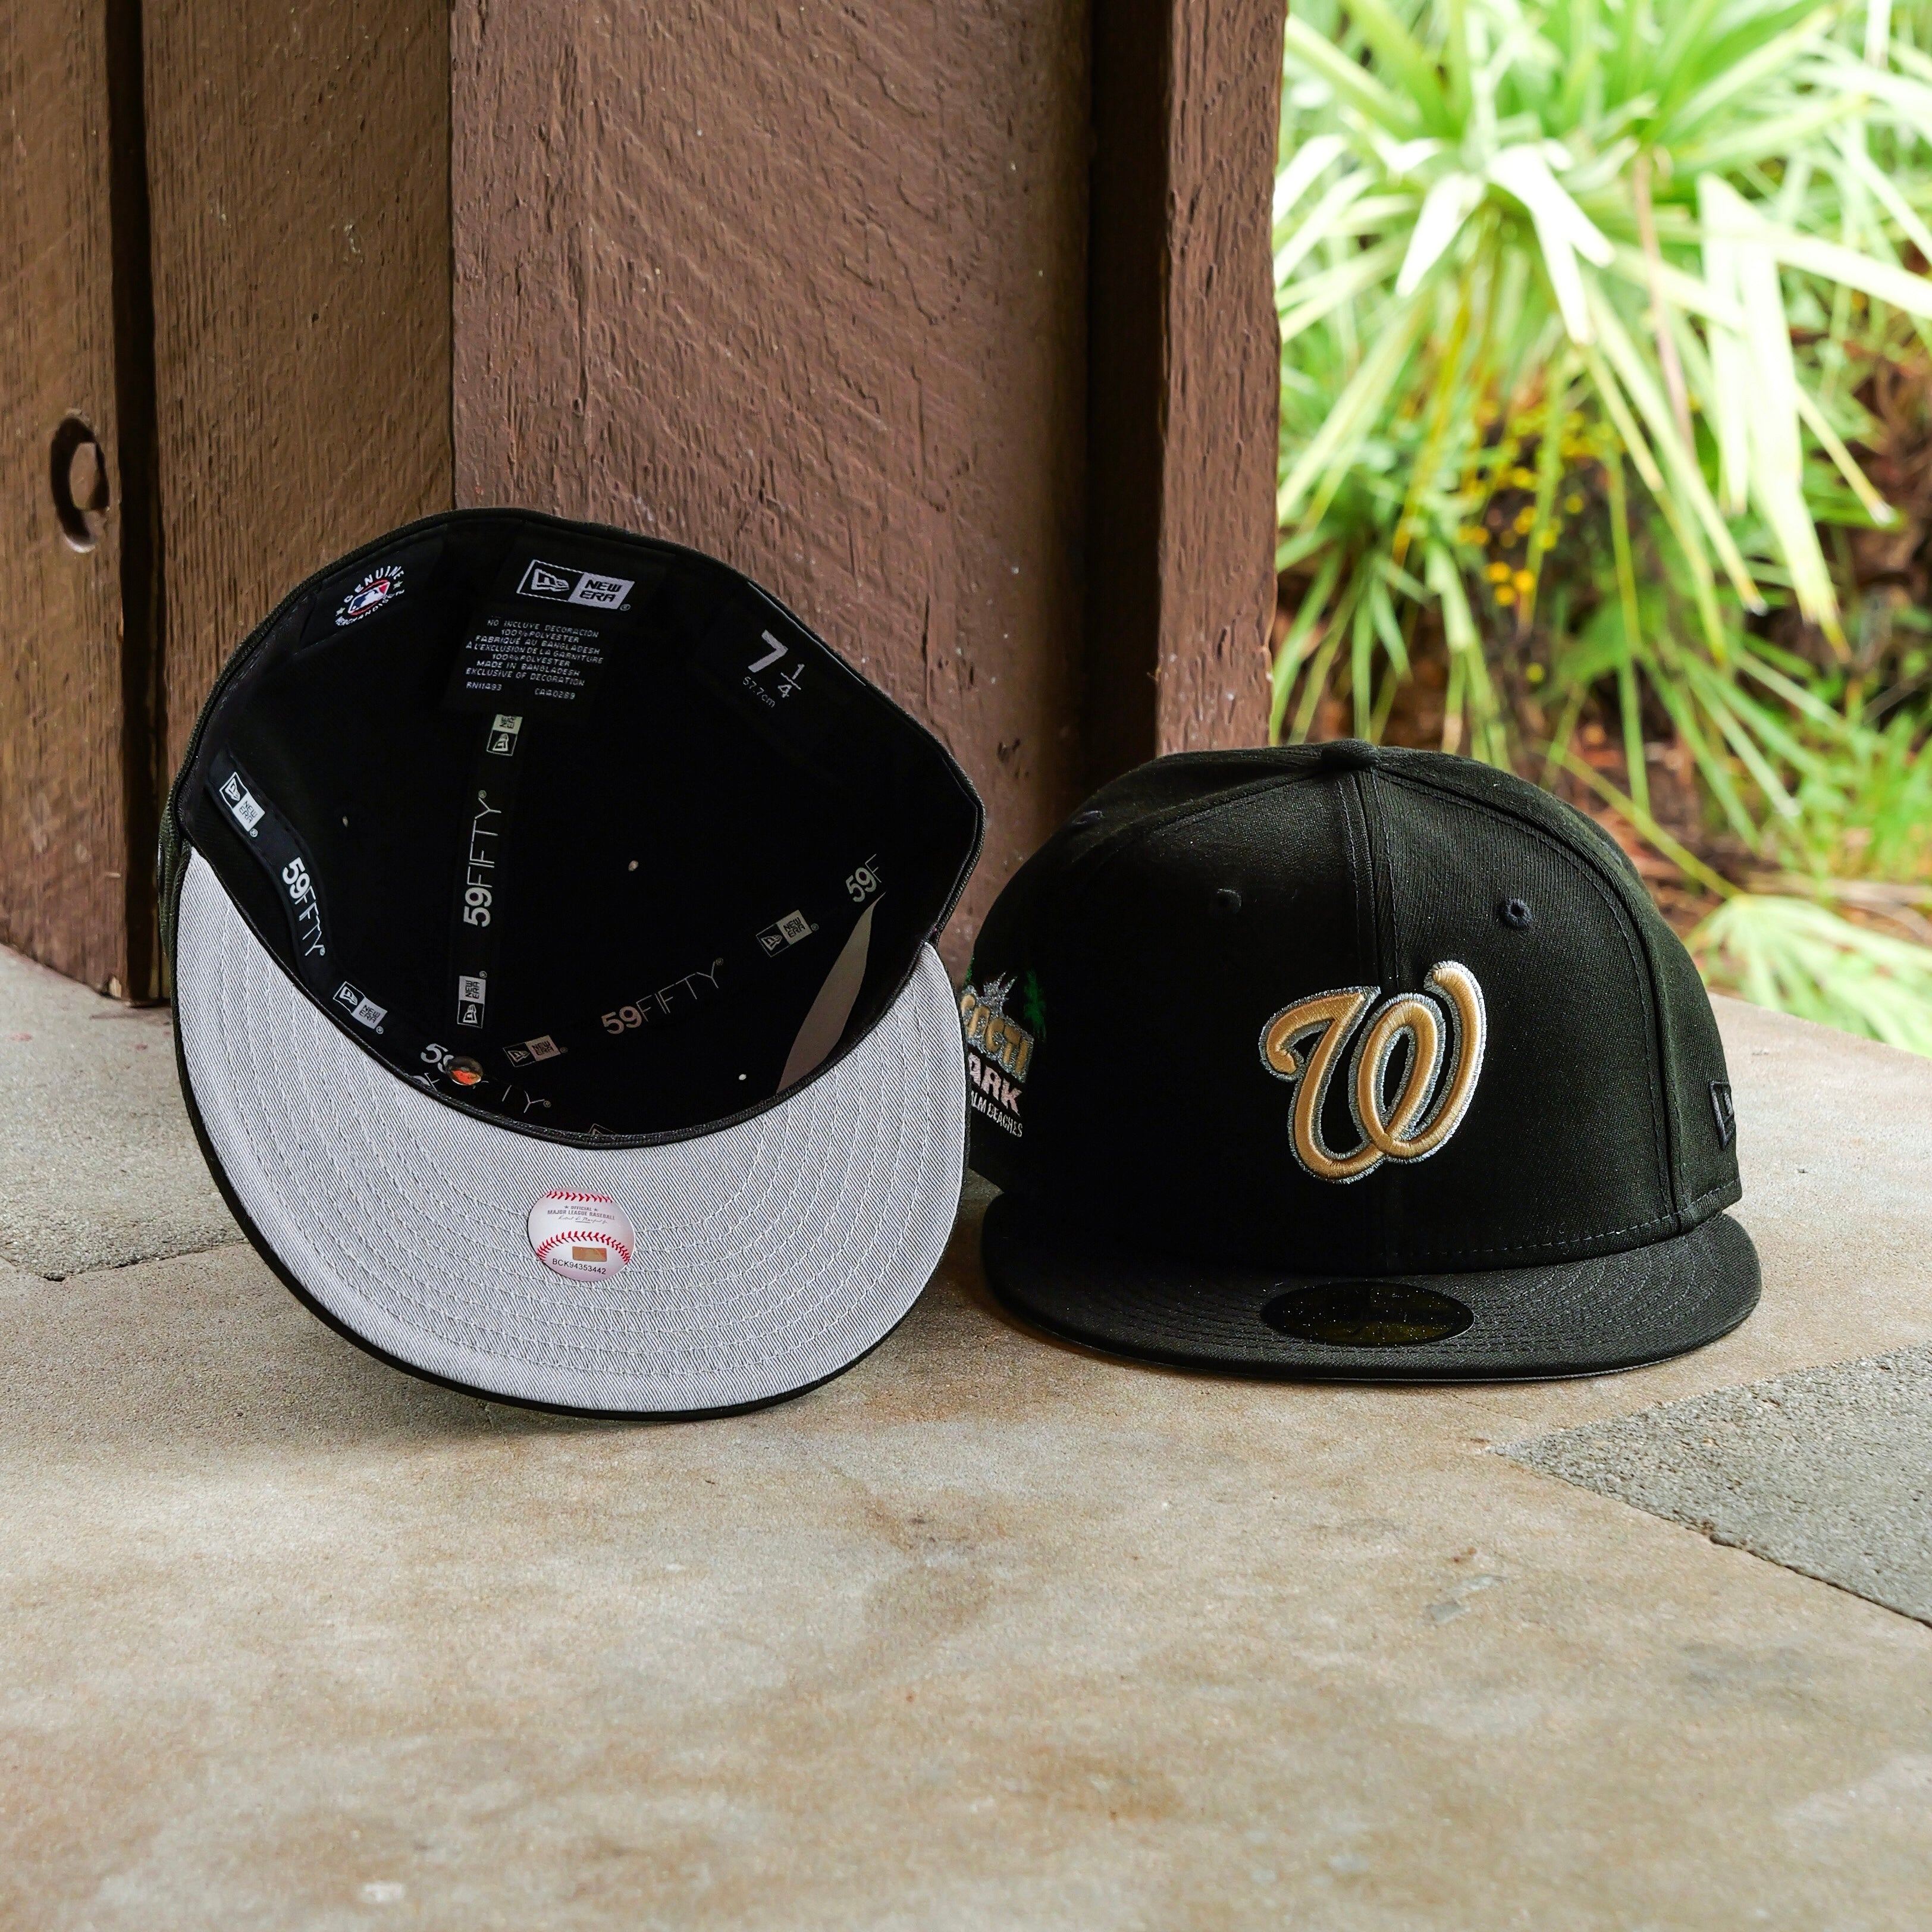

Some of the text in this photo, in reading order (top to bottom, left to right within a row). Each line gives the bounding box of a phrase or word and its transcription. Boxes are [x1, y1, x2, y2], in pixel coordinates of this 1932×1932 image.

[344, 566, 404, 603] GENUINE
[585, 579, 623, 592] NEW
[579, 591, 616, 602] ERA
[504, 620, 540, 629] INCLUYE
[544, 625, 599, 638] DECORACION
[541, 640, 600, 655] BANGLADESH
[748, 629, 789, 673] 7
[553, 650, 604, 664] GARNITURE
[466, 667, 513, 678] EXCLUSIVE
[530, 673, 585, 686] DECORATION
[521, 663, 581, 676] BANGLADESH
[239, 806, 253, 824] ERA
[243, 800, 258, 818] NEW
[463, 797, 502, 927] 59FIFTY
[282, 857, 325, 956] 59FIFTY
[783, 917, 802, 932] NEW
[787, 924, 805, 939] ERA
[465, 980, 473, 998] NEW
[601, 961, 719, 1034] 59FIFTY
[359, 1009, 377, 1023] ERA
[364, 1004, 381, 1018] NEW
[532, 1040, 551, 1049] NEW
[1258, 959, 1488, 1184] W
[968, 1052, 1023, 1117] ARK
[987, 1103, 1023, 1137] BEACHES
[553, 1258, 606, 1275] BCK94353442
